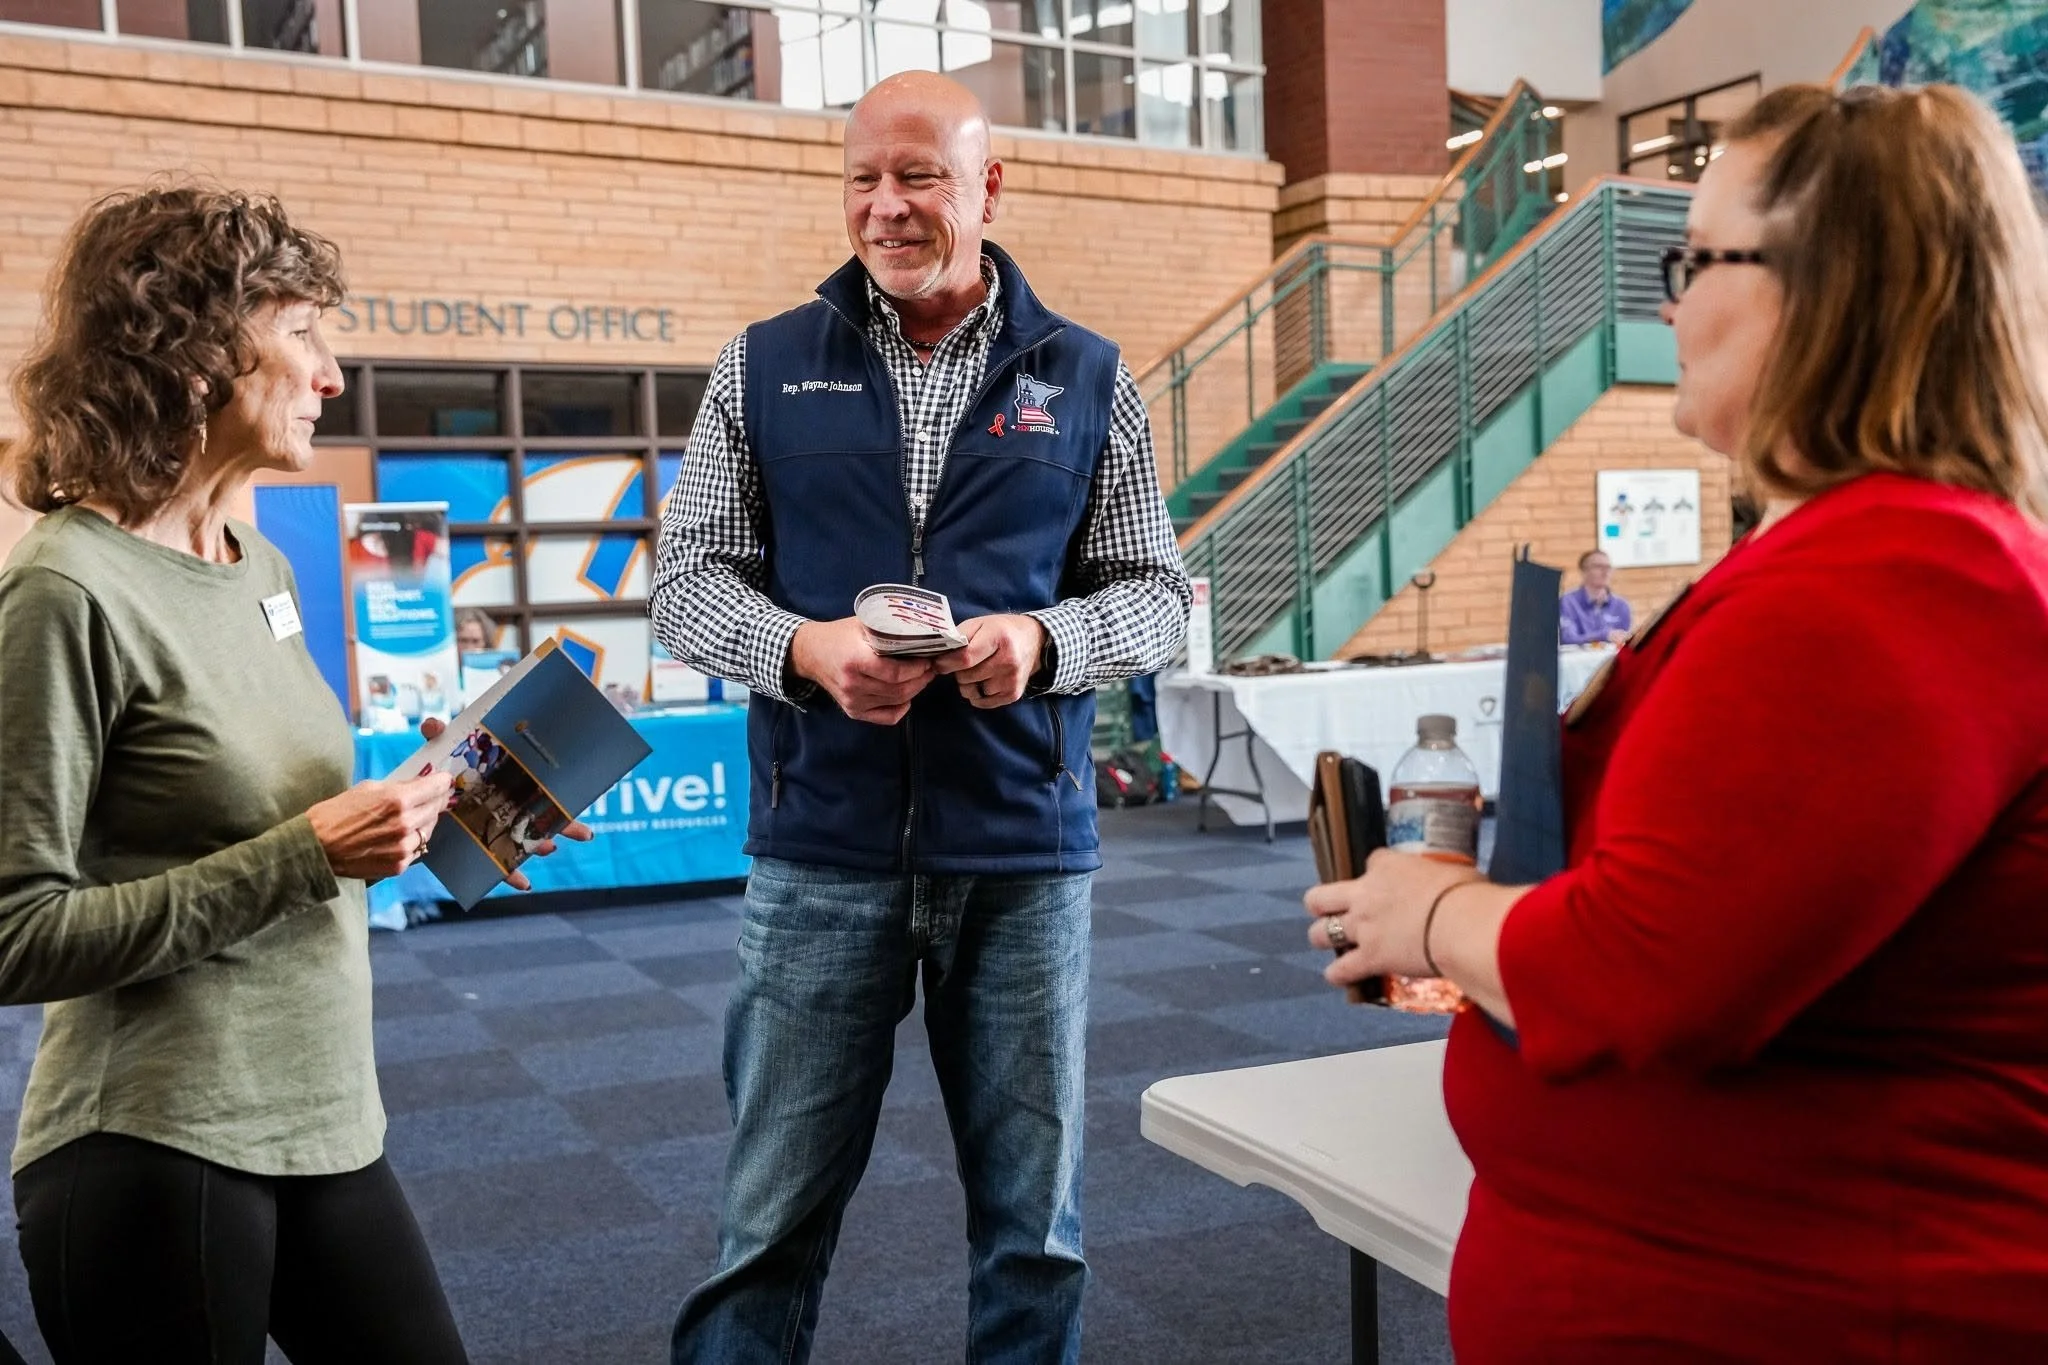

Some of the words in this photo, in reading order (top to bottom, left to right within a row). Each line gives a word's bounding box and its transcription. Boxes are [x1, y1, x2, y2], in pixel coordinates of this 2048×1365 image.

[338, 296, 530, 337] STUDENT
[549, 305, 675, 342] OFFICE
[782, 383, 800, 395] Rep.
[801, 381, 828, 392] Wayne
[828, 381, 862, 392] Johnson
[579, 761, 727, 817] rive!
